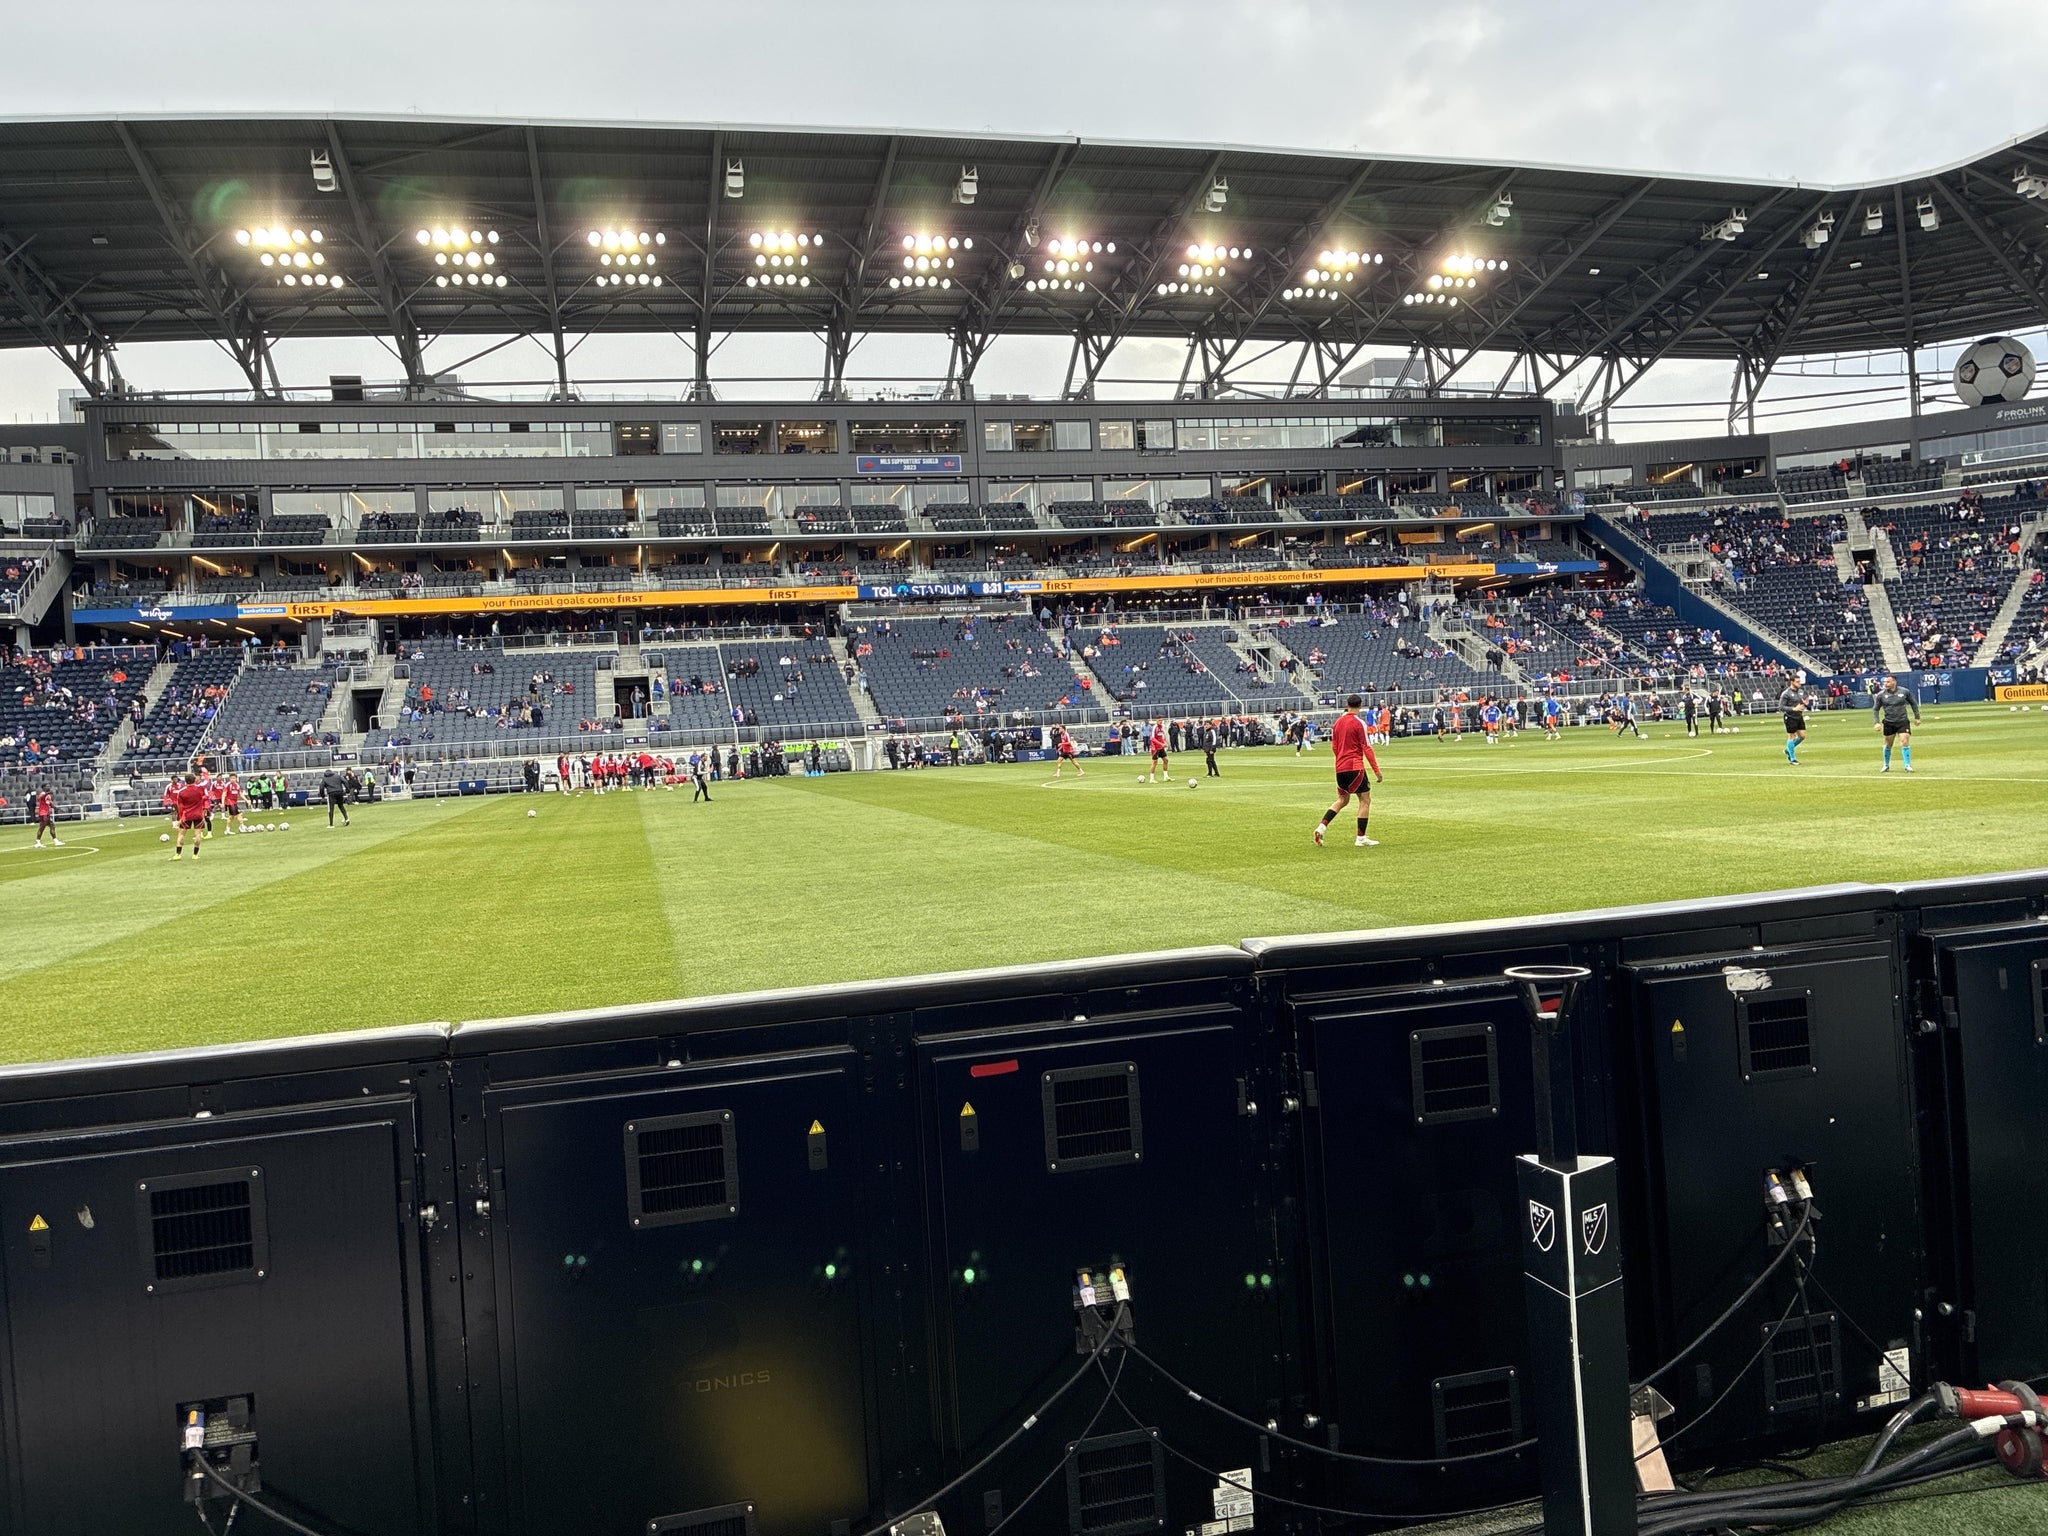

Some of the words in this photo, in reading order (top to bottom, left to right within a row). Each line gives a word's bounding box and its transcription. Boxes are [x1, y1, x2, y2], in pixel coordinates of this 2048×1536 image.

[2004, 406, 2047, 417] PROLINK
[1194, 576, 1214, 585] your
[1216, 574, 1251, 584] financial
[1253, 573, 1277, 583] goals
[872, 586, 897, 597] TQL
[911, 584, 966, 596] STADIUM
[982, 582, 1002, 594] 8:31
[483, 599, 506, 609] your
[510, 597, 553, 607] financial
[556, 595, 585, 606] goals
[587, 596, 615, 604] come
[1530, 1204, 1546, 1218] MLS
[1584, 1210, 1599, 1224] MLS
